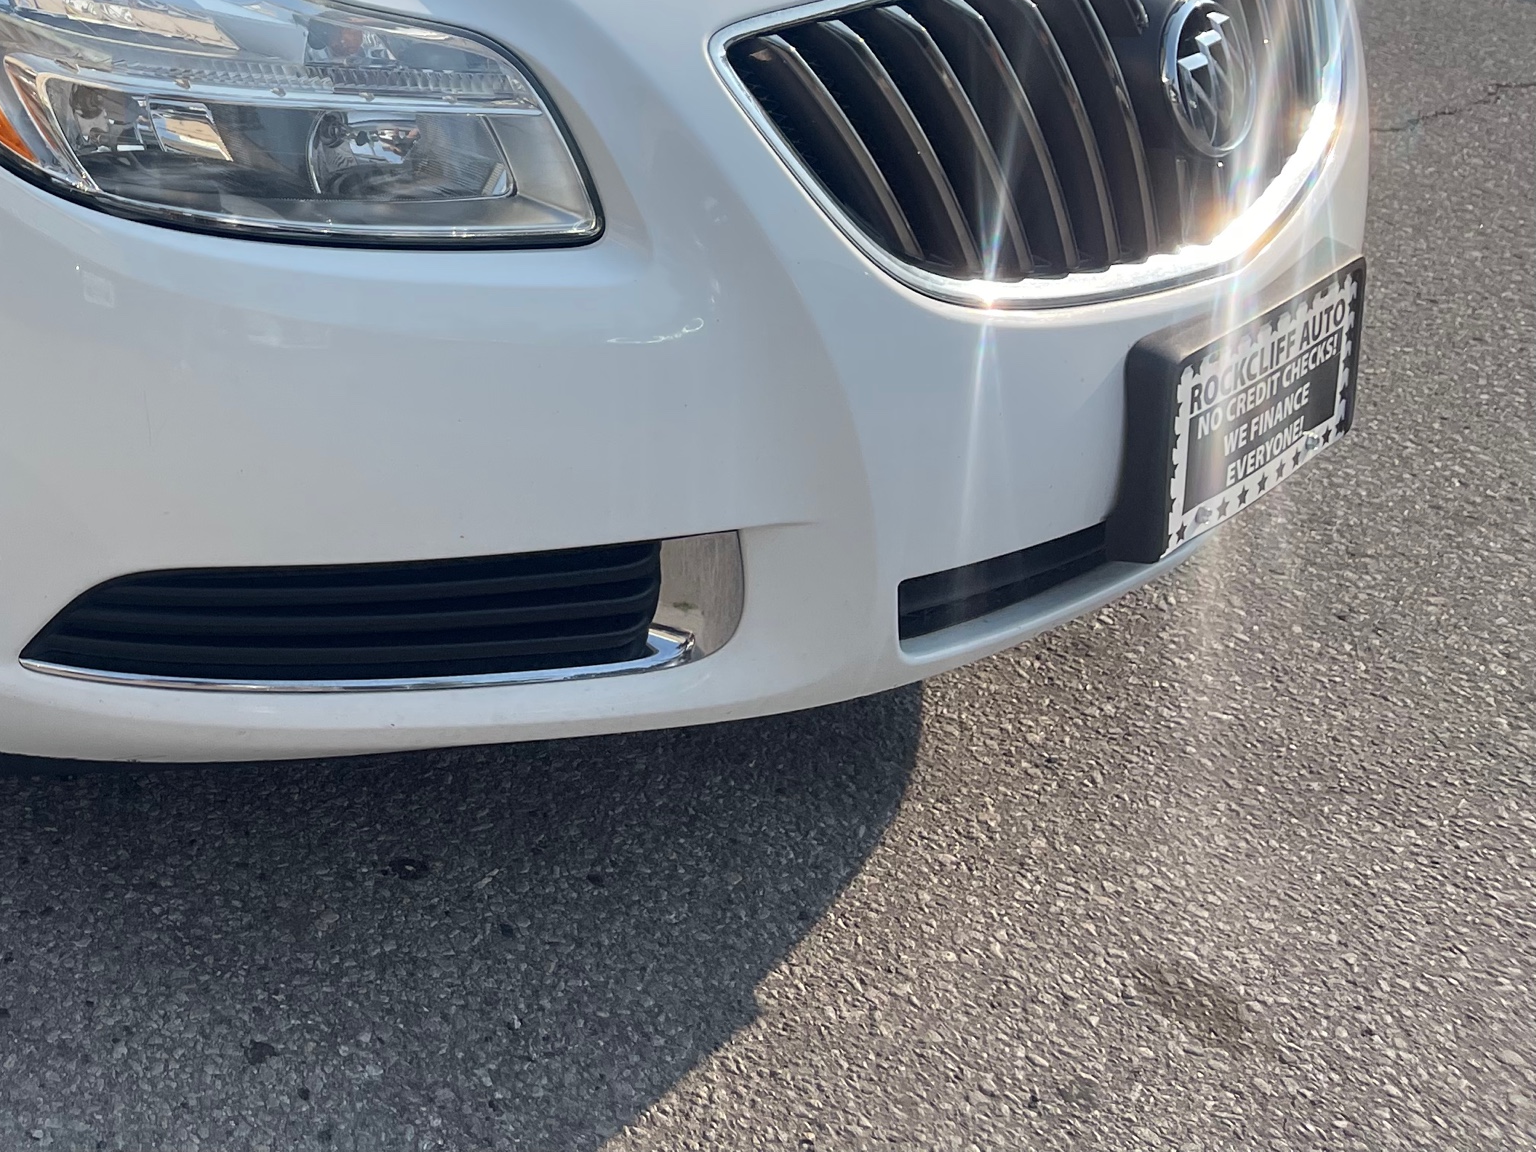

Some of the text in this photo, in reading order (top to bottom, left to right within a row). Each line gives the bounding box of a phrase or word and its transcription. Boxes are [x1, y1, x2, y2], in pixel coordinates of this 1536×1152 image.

[1191, 298, 1346, 412] ROCKCLIFF AUTO
[1197, 337, 1338, 440] NO CREDIT CHECKS!
[1224, 382, 1311, 457] WE FINANCE
[1226, 415, 1304, 487] EVERYONE!
